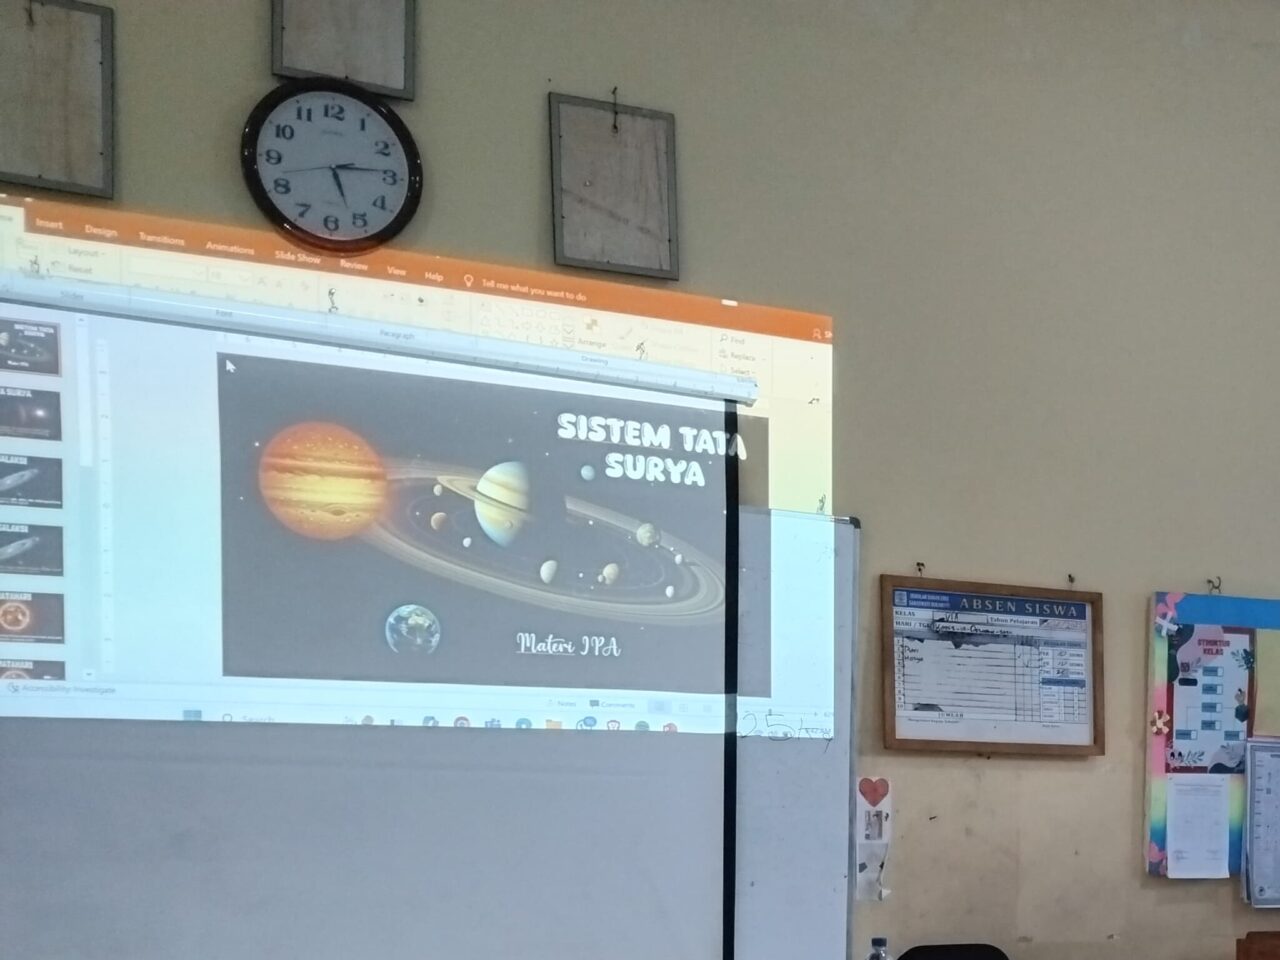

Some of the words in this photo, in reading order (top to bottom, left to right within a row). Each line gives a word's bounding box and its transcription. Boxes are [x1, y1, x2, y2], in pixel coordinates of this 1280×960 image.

[296, 106, 312, 122] 11
[323, 104, 345, 121] 12
[274, 124, 295, 140] 10
[359, 118, 366, 131] 1
[265, 149, 282, 165] 9
[375, 140, 391, 157] 2
[382, 169, 397, 186] 3
[273, 178, 291, 195] 8
[295, 203, 312, 218] 7
[372, 195, 387, 210] 4
[323, 215, 340, 232] 6
[352, 212, 367, 228] 5
[36, 217, 63, 230] Insert
[85, 225, 118, 238] Design
[139, 232, 185, 246] Transitions
[206, 240, 255, 256] Animations
[275, 250, 295, 261] Slide
[297, 252, 321, 264] Show
[340, 259, 368, 271] Review
[387, 266, 406, 276] View
[425, 271, 443, 283] Help
[482, 279, 495, 288] Tell
[497, 282, 509, 291] me
[510, 283, 529, 294] what
[530, 286, 546, 297] you
[547, 288, 566, 299] want
[576, 292, 587, 302] do
[557, 412, 671, 449] SISTEM
[679, 426, 747, 461] TATA
[605, 452, 705, 487] SURYA
[960, 598, 1016, 612] ABSEN
[1025, 602, 1077, 617] SISWA
[1009, 618, 1038, 626] Pelajaran
[516, 632, 576, 654] Materi
[580, 635, 622, 657] IPA
